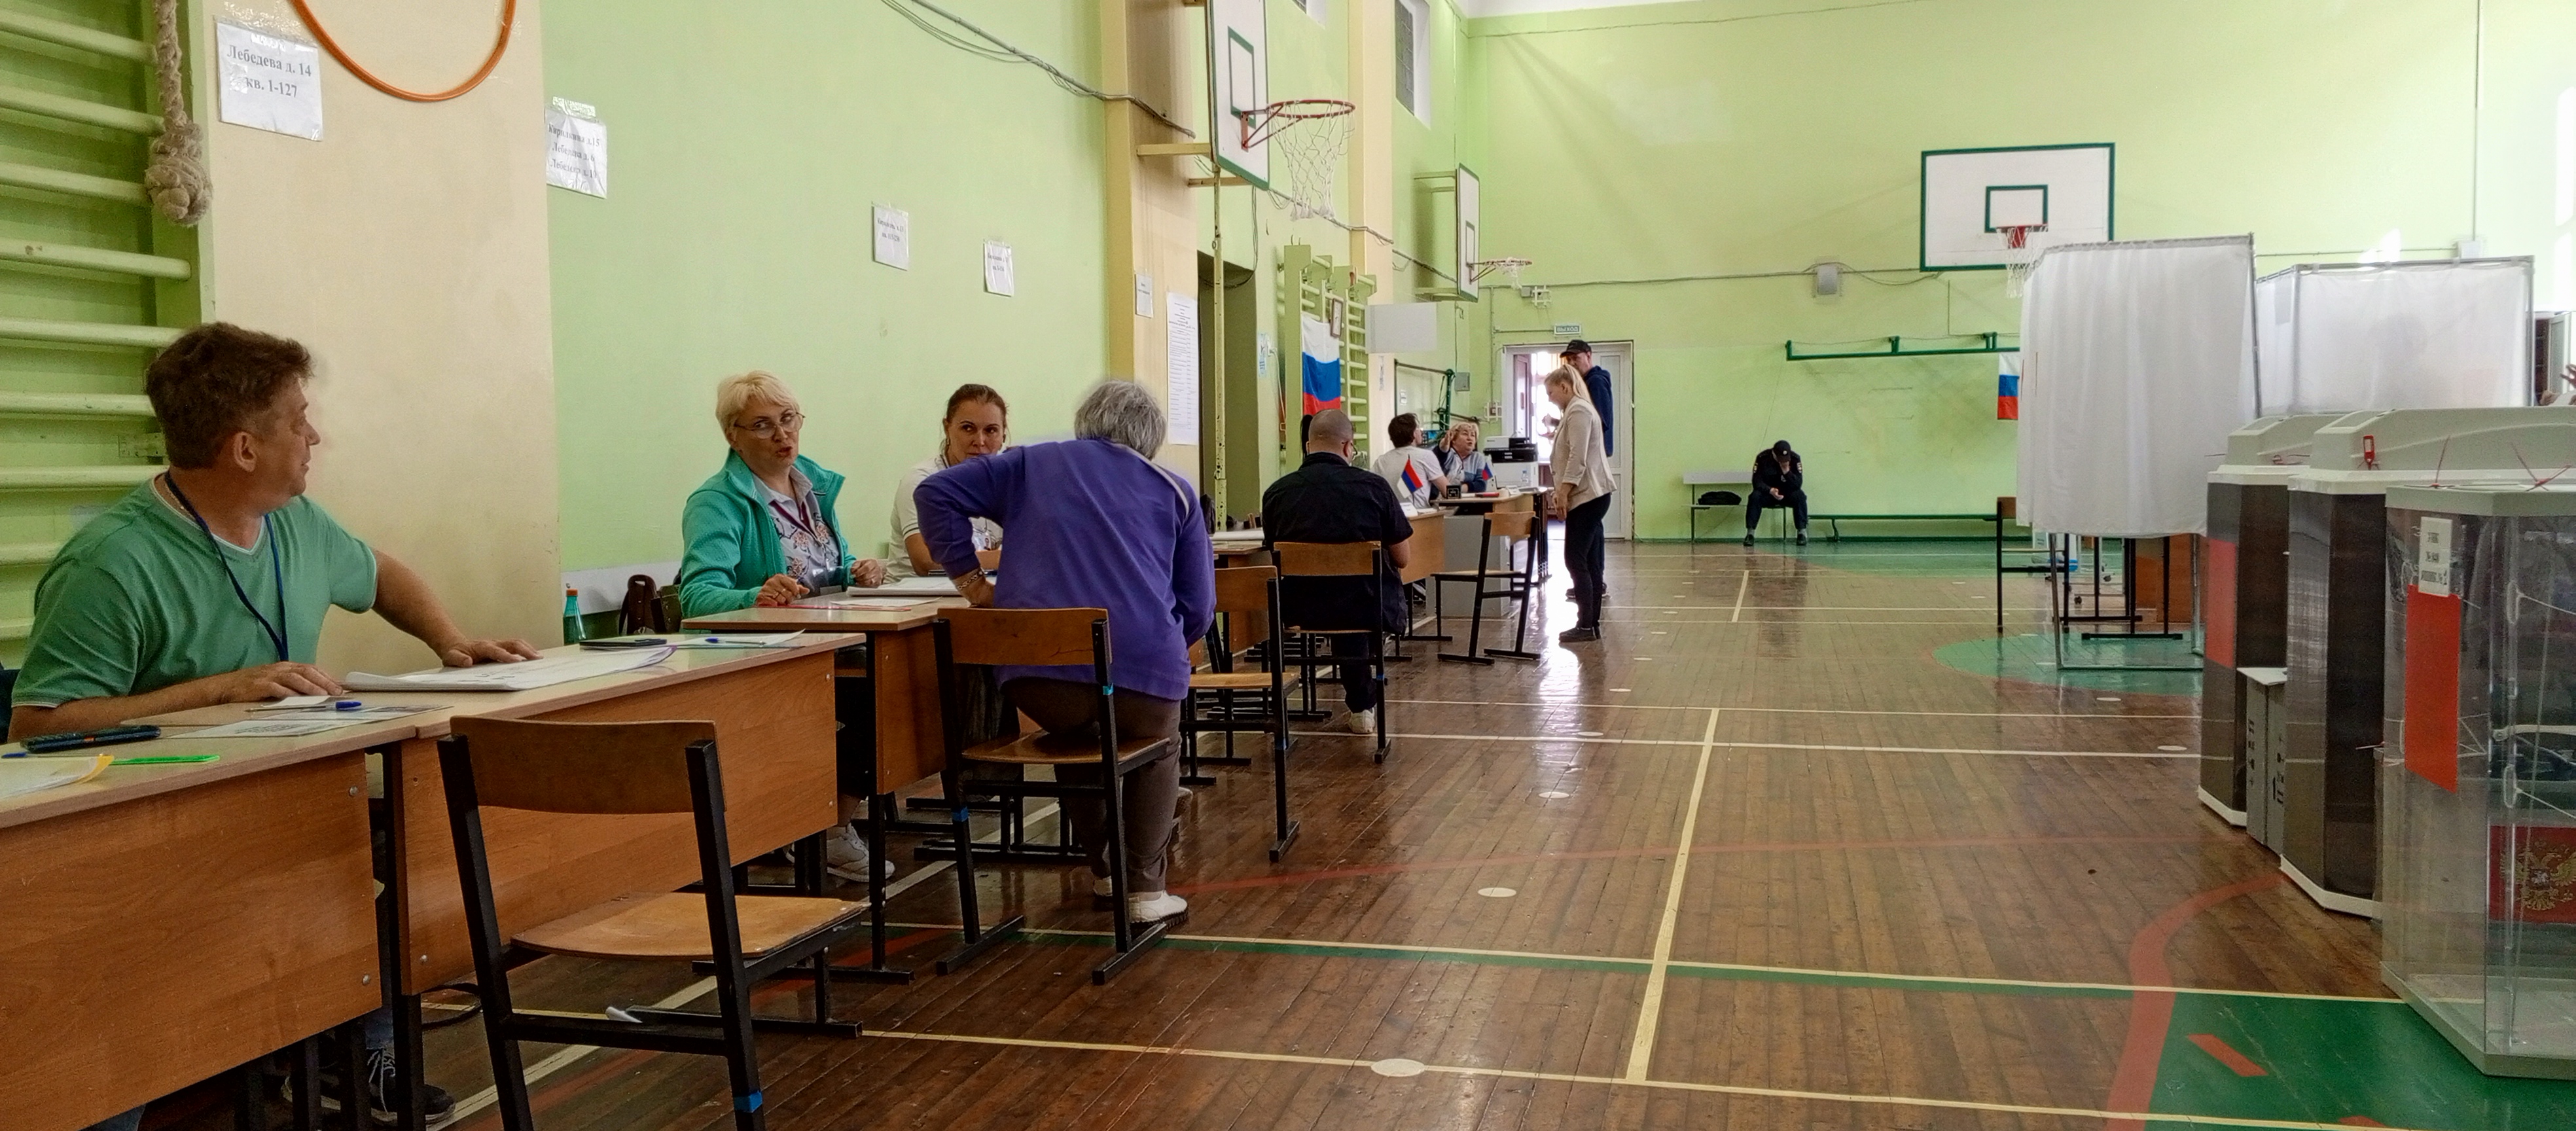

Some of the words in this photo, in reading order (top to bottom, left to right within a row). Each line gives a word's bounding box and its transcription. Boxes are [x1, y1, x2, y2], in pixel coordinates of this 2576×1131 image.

[227, 45, 282, 70] Лебедева
[285, 63, 296, 74] д.
[299, 63, 312, 77] 14
[245, 77, 264, 90] кв.
[268, 79, 297, 98] 1-127
